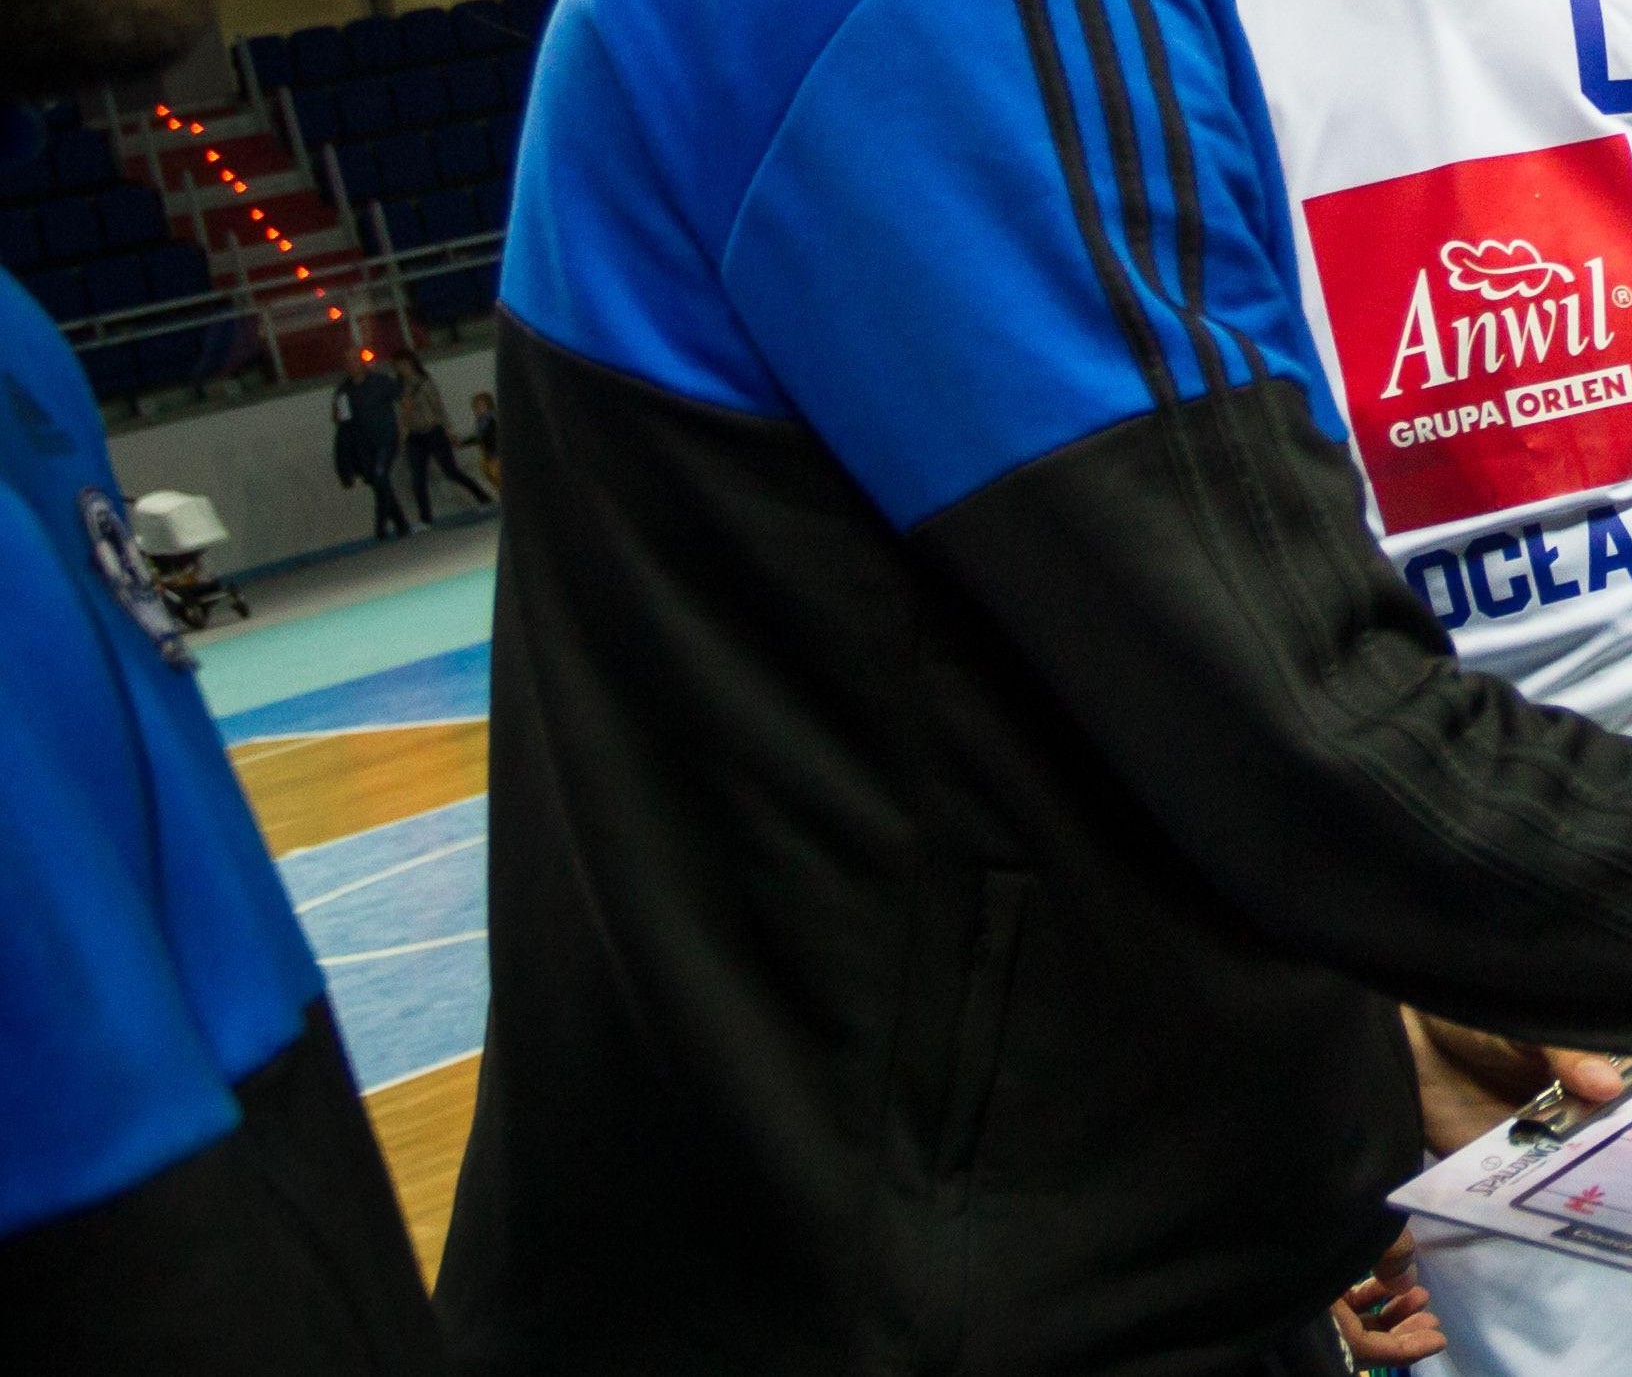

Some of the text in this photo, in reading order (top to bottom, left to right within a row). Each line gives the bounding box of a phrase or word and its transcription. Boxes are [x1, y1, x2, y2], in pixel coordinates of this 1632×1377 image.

[1380, 256, 1615, 400] Anwil
[1389, 373, 1628, 448] GRUPA ORLEN
